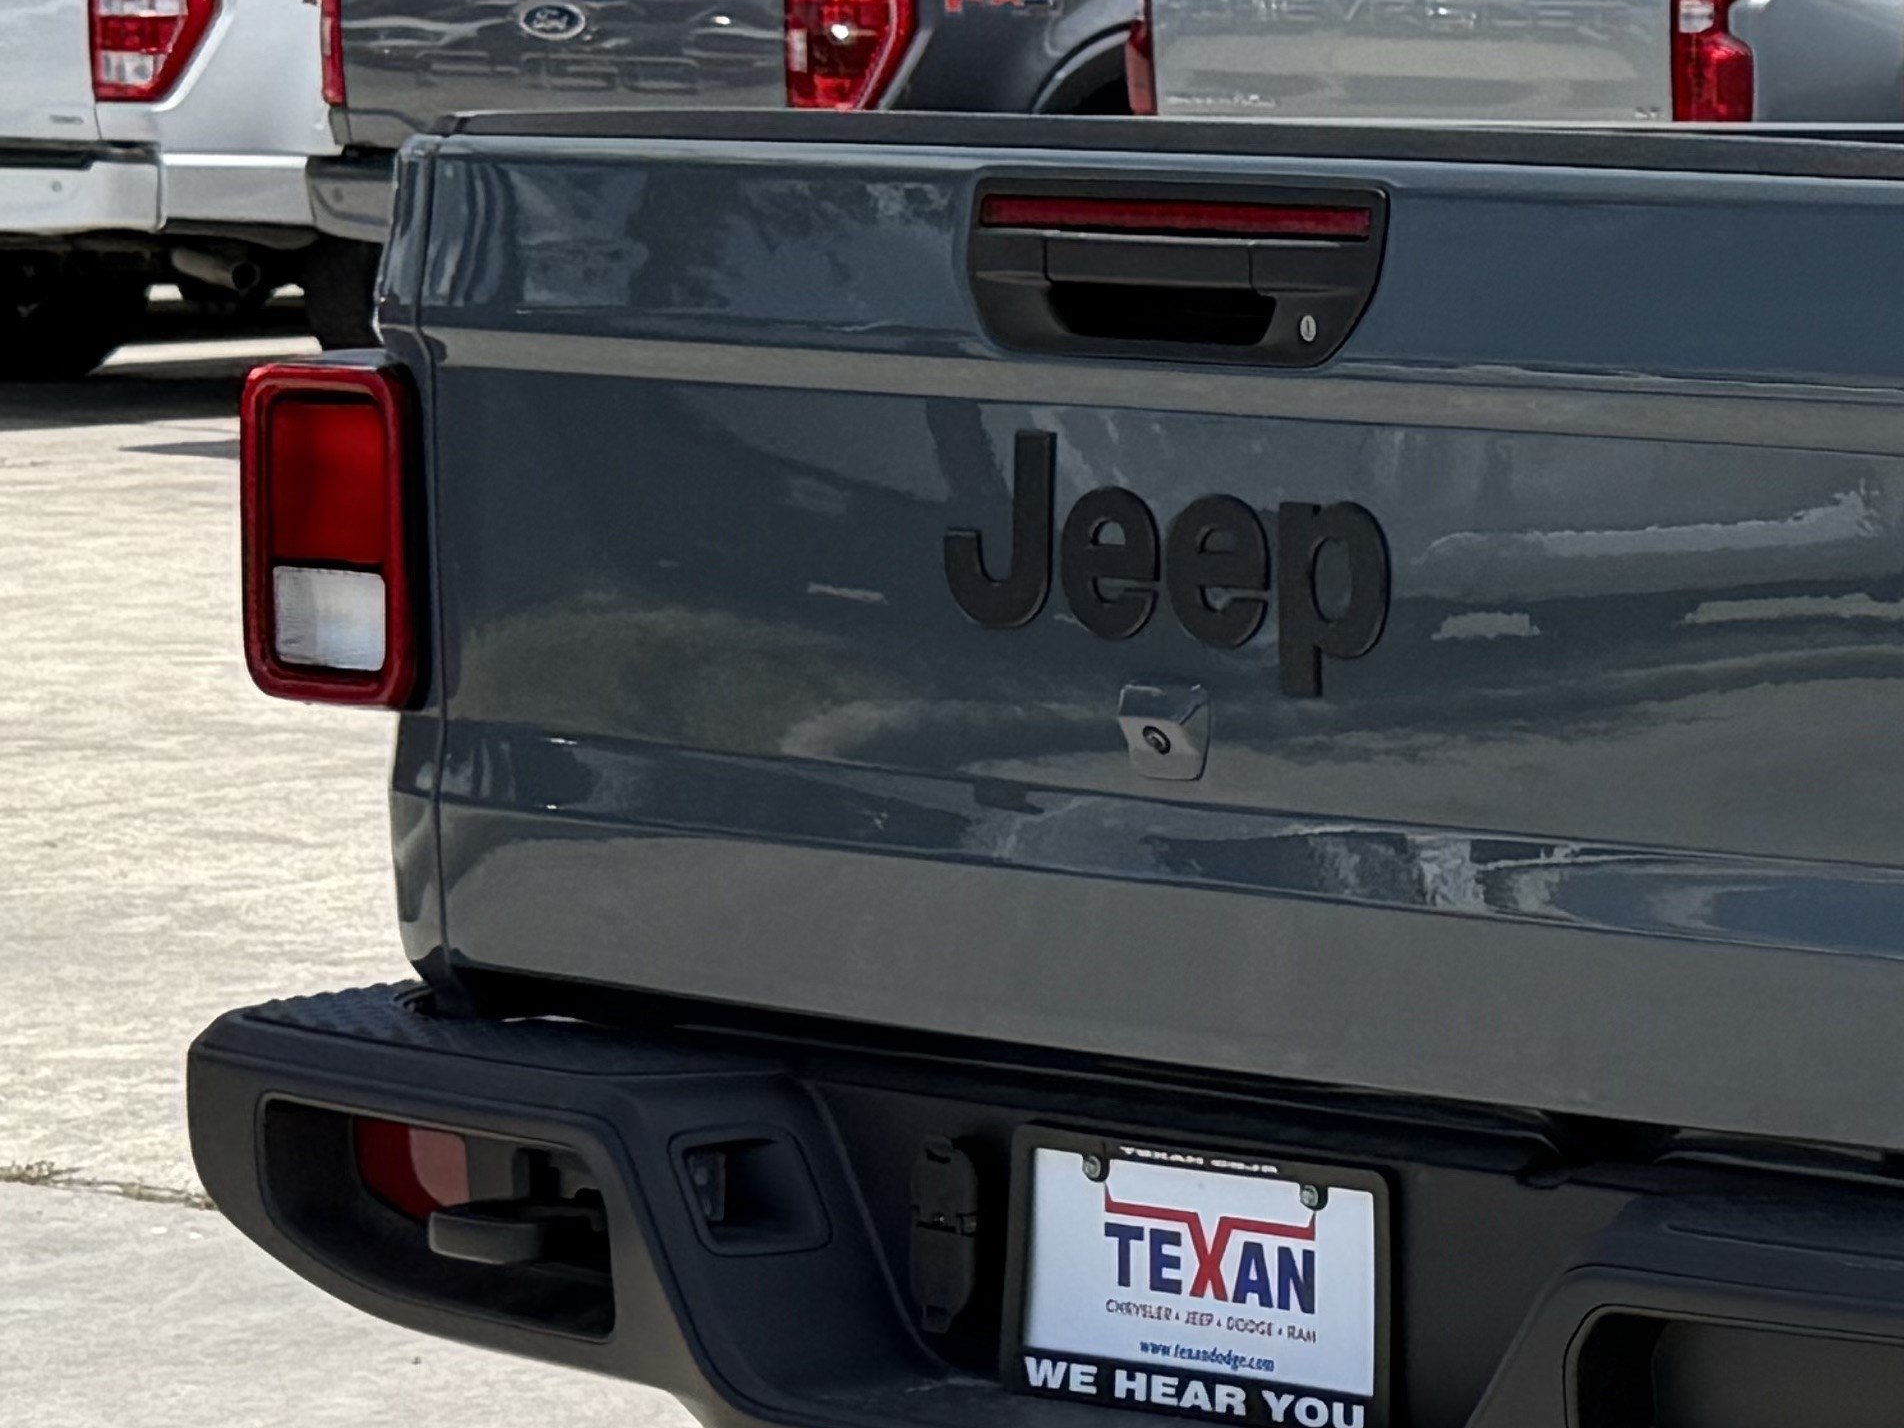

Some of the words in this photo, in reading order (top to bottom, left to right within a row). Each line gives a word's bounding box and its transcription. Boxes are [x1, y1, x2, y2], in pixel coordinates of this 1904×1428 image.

[943, 429, 1392, 698] Jeep
[1104, 1210, 1316, 1315] TEXAN
[1105, 1298, 1172, 1321] CHRYSLER
[1184, 1310, 1214, 1328] JEEP
[1226, 1316, 1273, 1337] DODGE
[1286, 1324, 1317, 1344] RAM
[1024, 1356, 1098, 1395] WE
[1113, 1369, 1247, 1417] HEAR
